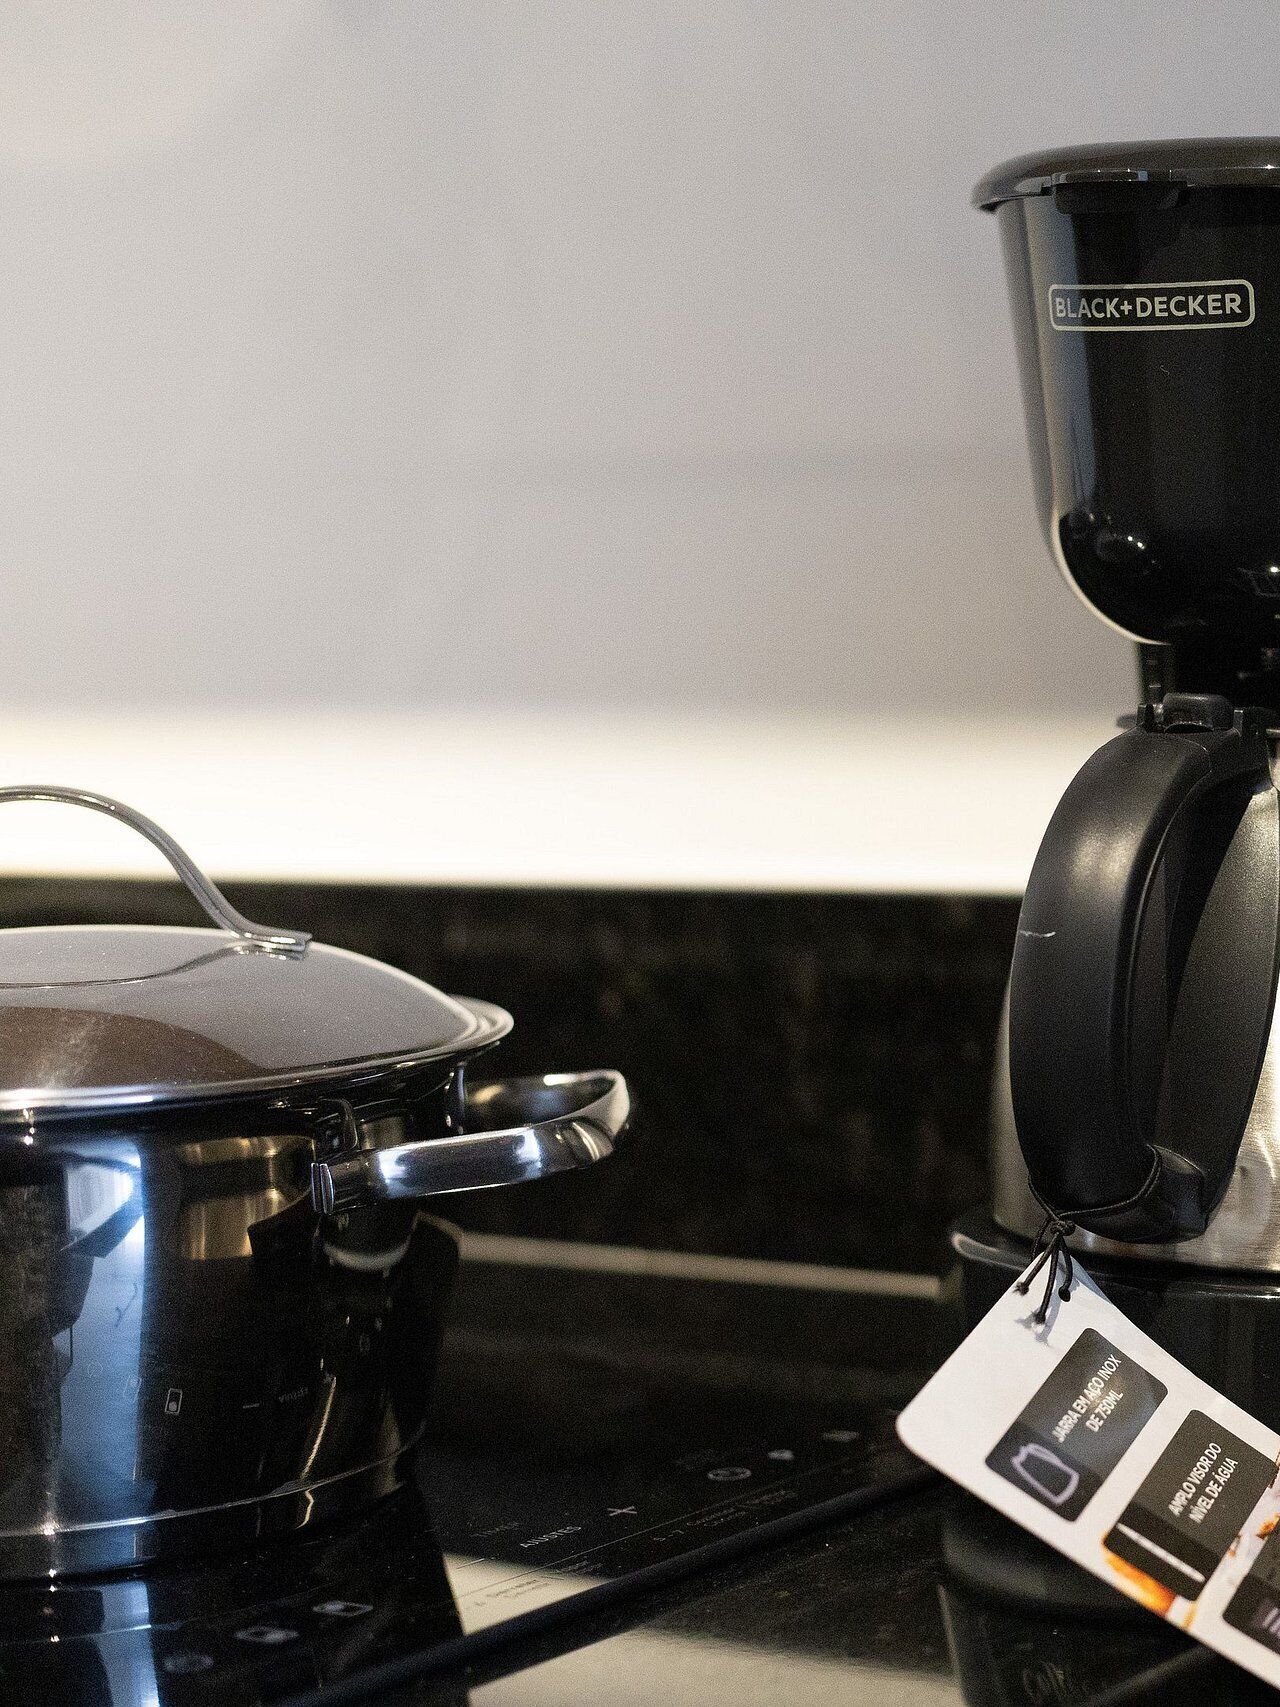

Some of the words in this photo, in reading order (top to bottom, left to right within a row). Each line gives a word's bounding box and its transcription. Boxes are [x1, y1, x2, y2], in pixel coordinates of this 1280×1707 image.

[1055, 293, 1242, 318] BLACK+DECKER
[1051, 1409, 1082, 1443] JARRA
[1072, 1395, 1091, 1414] EM
[1097, 1354, 1121, 1381] INOX
[1094, 1389, 1124, 1419] 750ML
[1085, 1413, 1104, 1432] DE
[1168, 1481, 1197, 1517] AMPLO
[1187, 1455, 1214, 1485] VISOR
[1204, 1442, 1221, 1460] DO
[1211, 1457, 1239, 1486] ÁGUA
[1205, 1480, 1223, 1498] DE
[1188, 1495, 1215, 1523] NÍVEL
